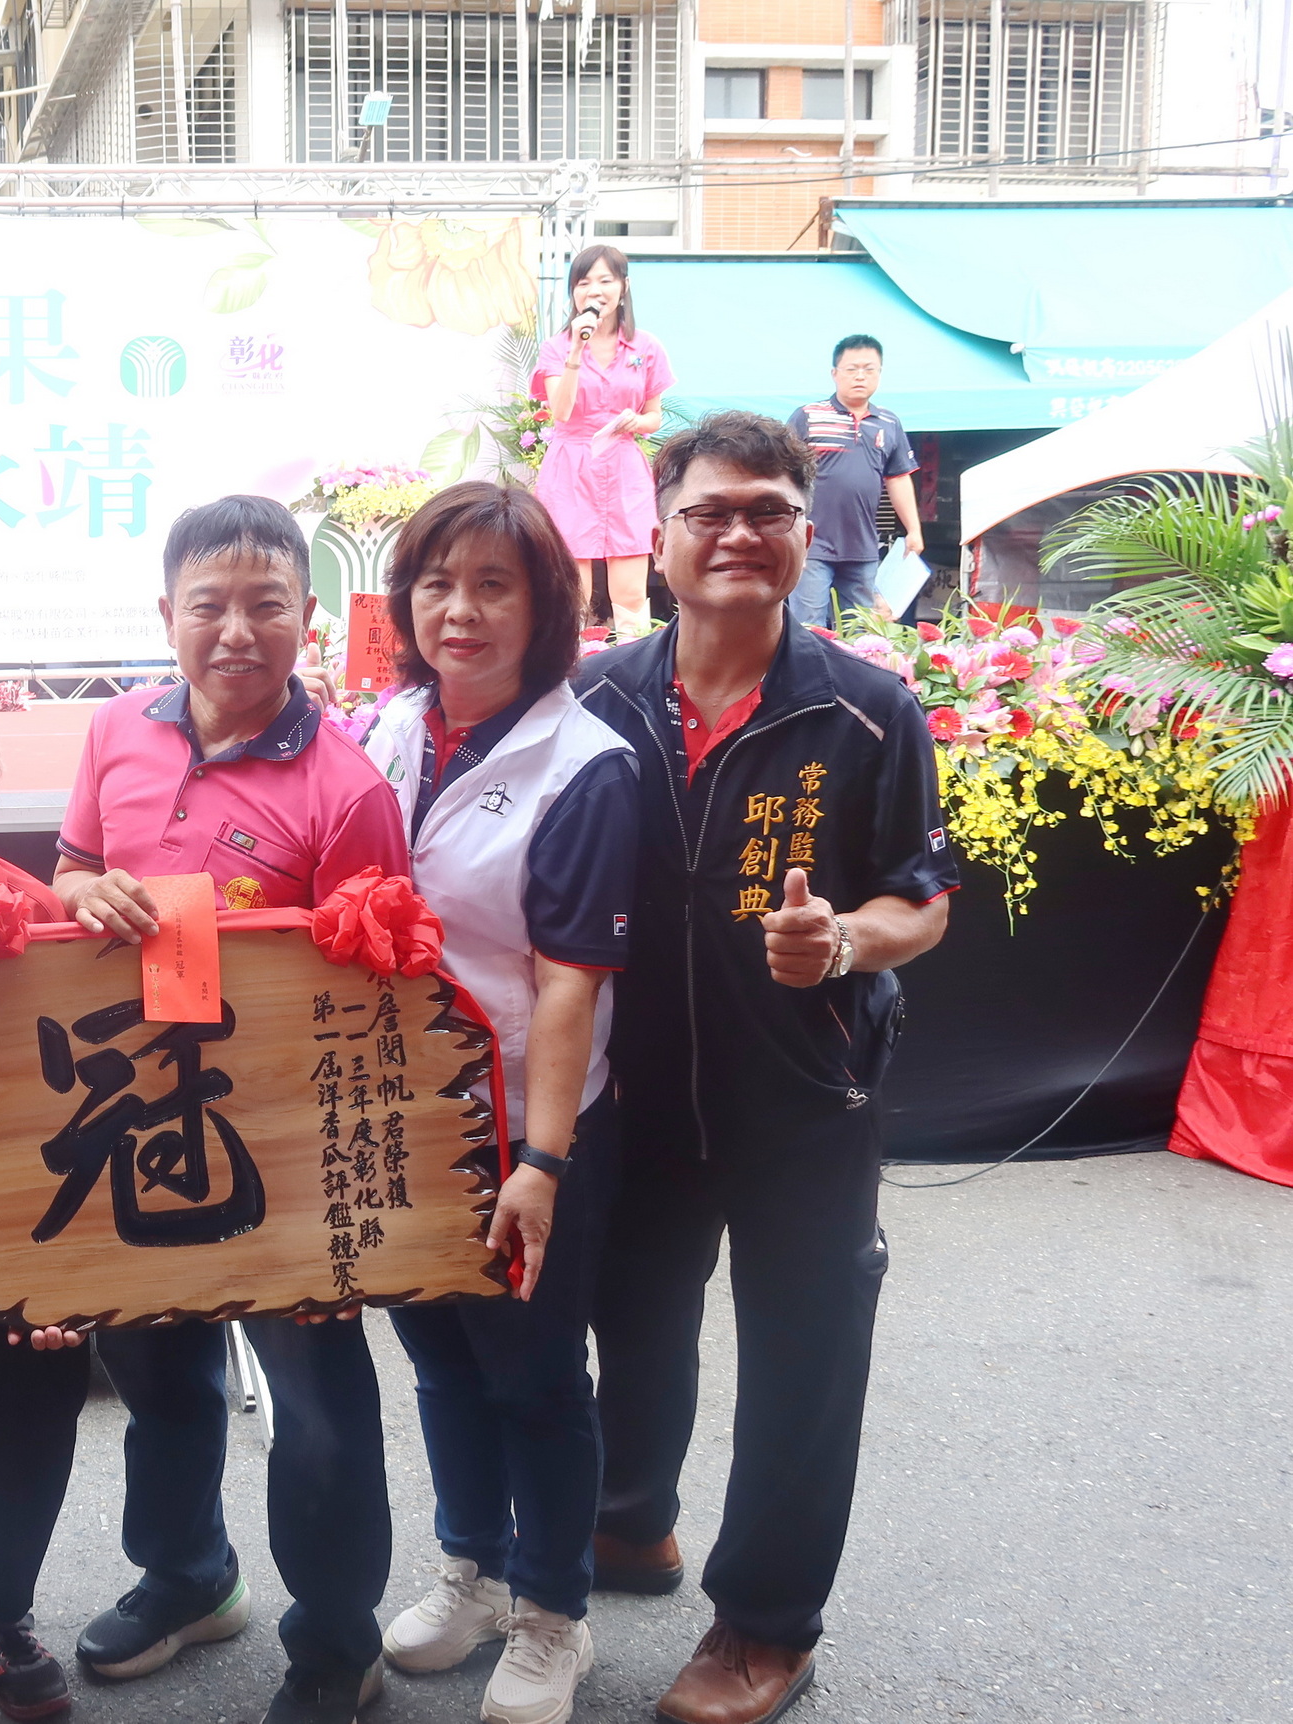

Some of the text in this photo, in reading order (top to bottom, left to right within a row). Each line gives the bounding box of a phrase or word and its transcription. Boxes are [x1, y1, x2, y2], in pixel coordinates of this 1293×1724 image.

[229, 334, 284, 370] 彰化
[731, 792, 786, 922] 邱創典
[784, 761, 828, 873] 常務監
[310, 990, 359, 1296] 第一屆洋香瓜評鑑競賽
[342, 1004, 385, 1249] 一一三年度彰化縣
